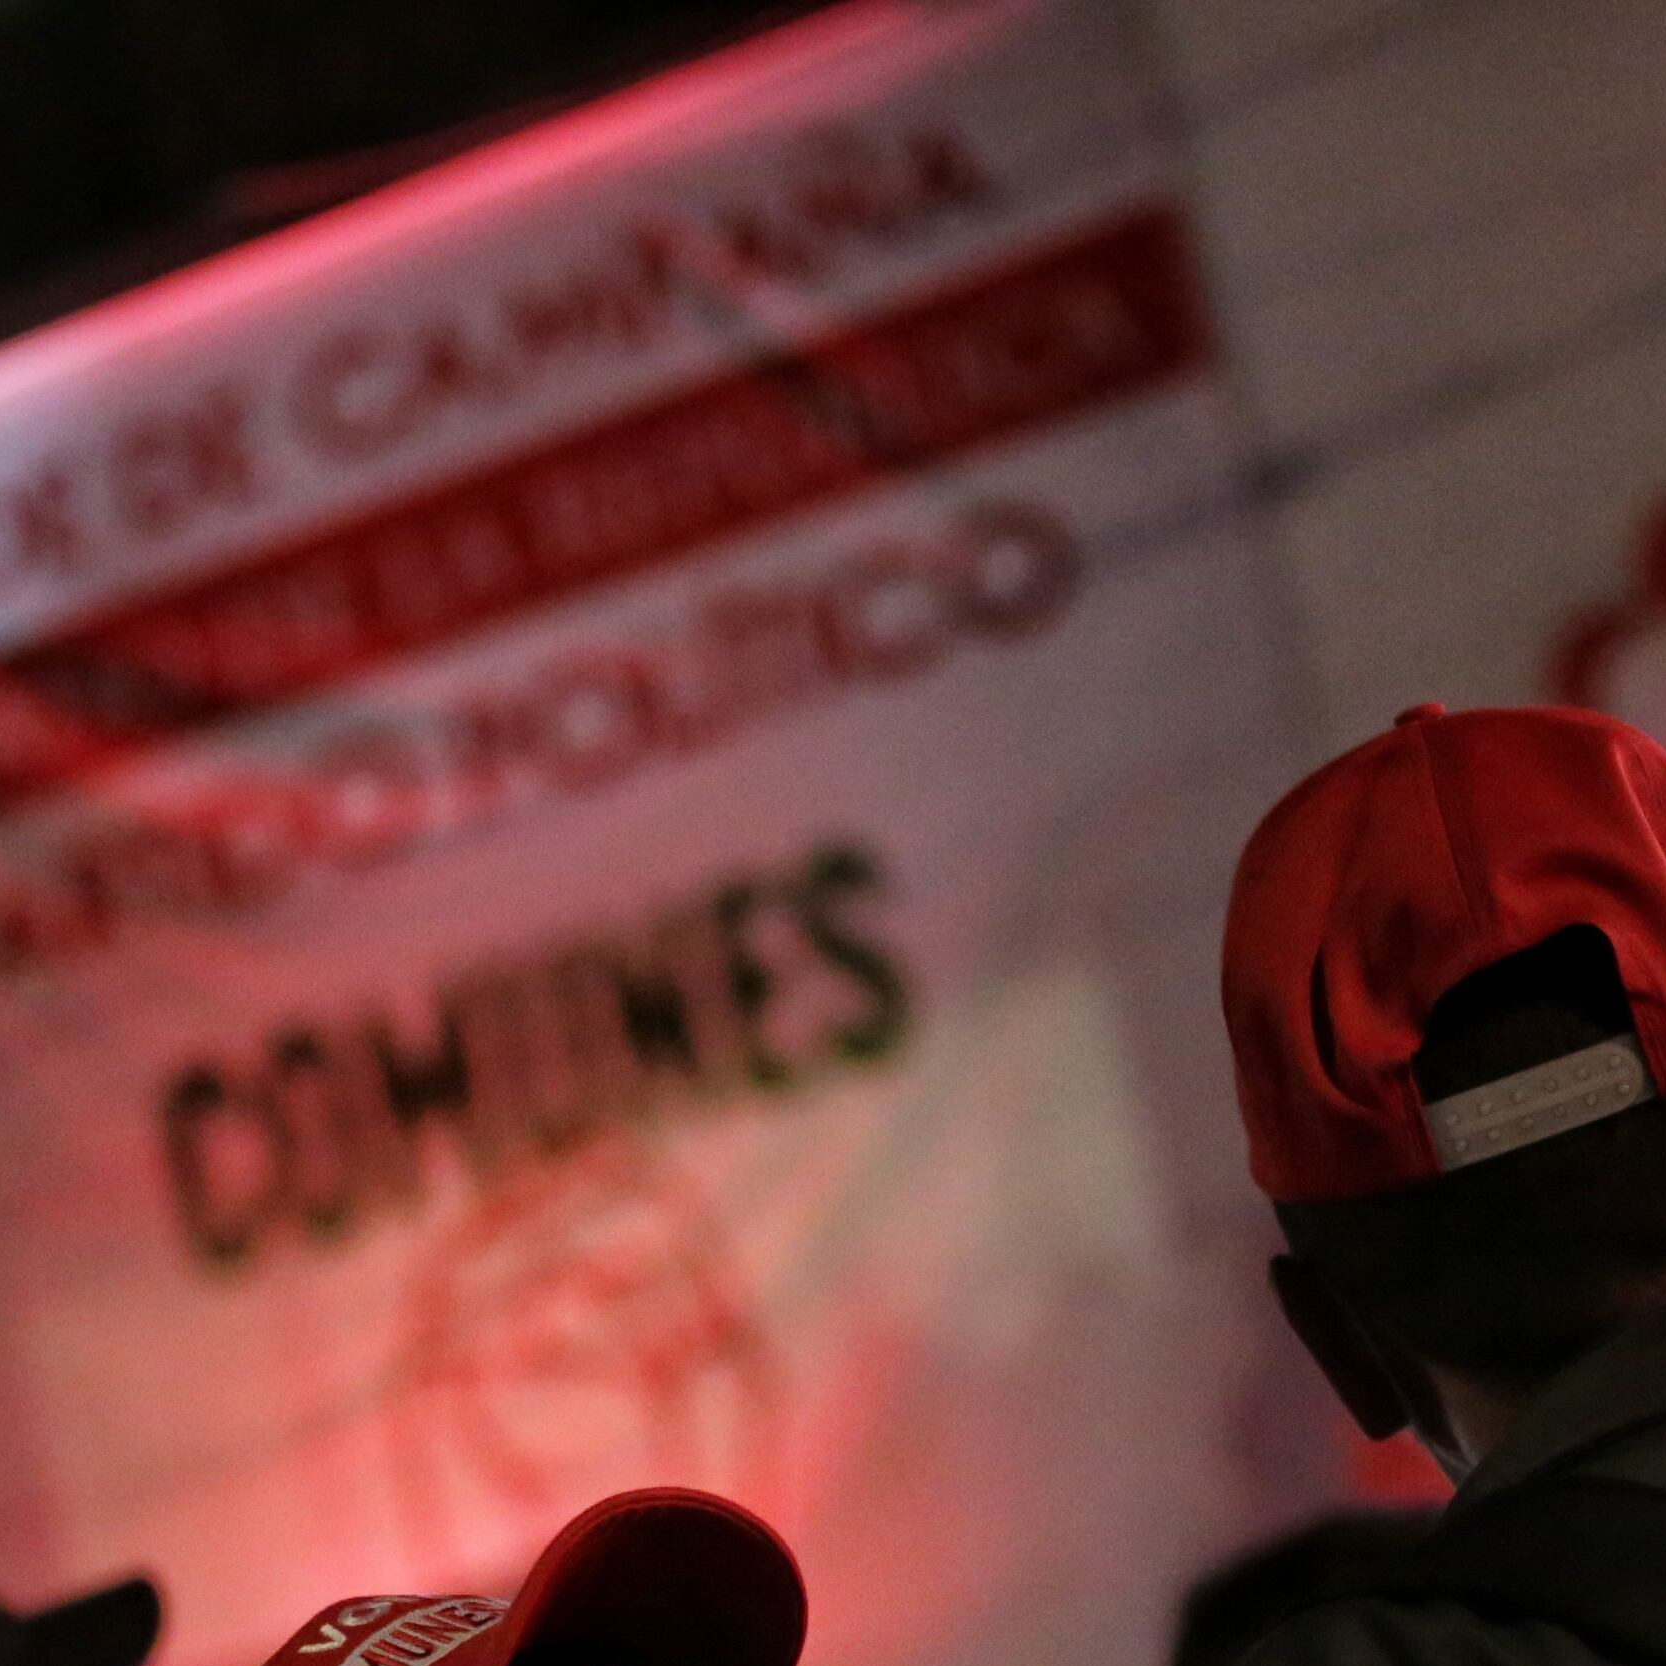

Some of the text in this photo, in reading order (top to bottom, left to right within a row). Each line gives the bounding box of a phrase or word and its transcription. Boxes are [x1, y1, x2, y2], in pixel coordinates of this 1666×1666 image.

[112, 406, 254, 531] DE
[295, 119, 985, 450] CAMPAÑA
[165, 840, 911, 1280] COMUNES
[297, 1595, 411, 1653] VO
